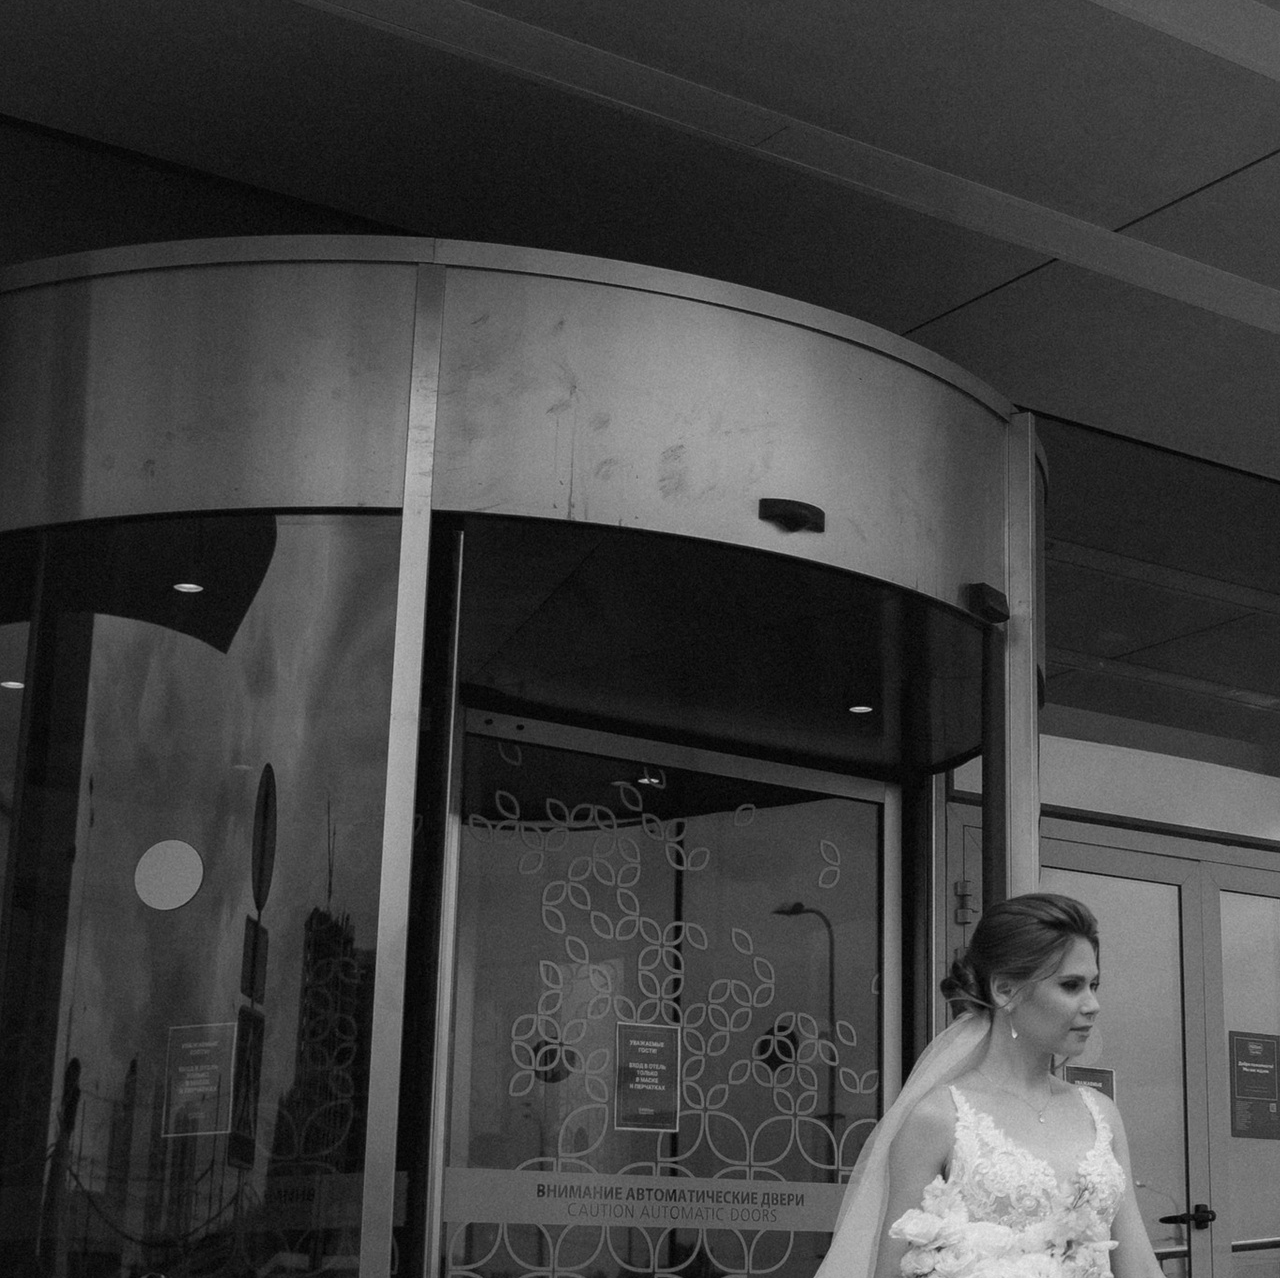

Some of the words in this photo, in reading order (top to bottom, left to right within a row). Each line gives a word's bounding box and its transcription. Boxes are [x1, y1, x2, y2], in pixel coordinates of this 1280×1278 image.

[629, 1039, 665, 1048] УВАЖАЕМЫЕ
[536, 1183, 623, 1201] ВНИМАНИЕ
[625, 1187, 759, 1206] АВТОМАТИЧЕСКИЕ
[761, 1192, 805, 1208] ДВЕРИ
[567, 1202, 635, 1219] CAUTION
[640, 1205, 724, 1221] AUTOMATIC
[730, 1207, 778, 1223] DOORS
